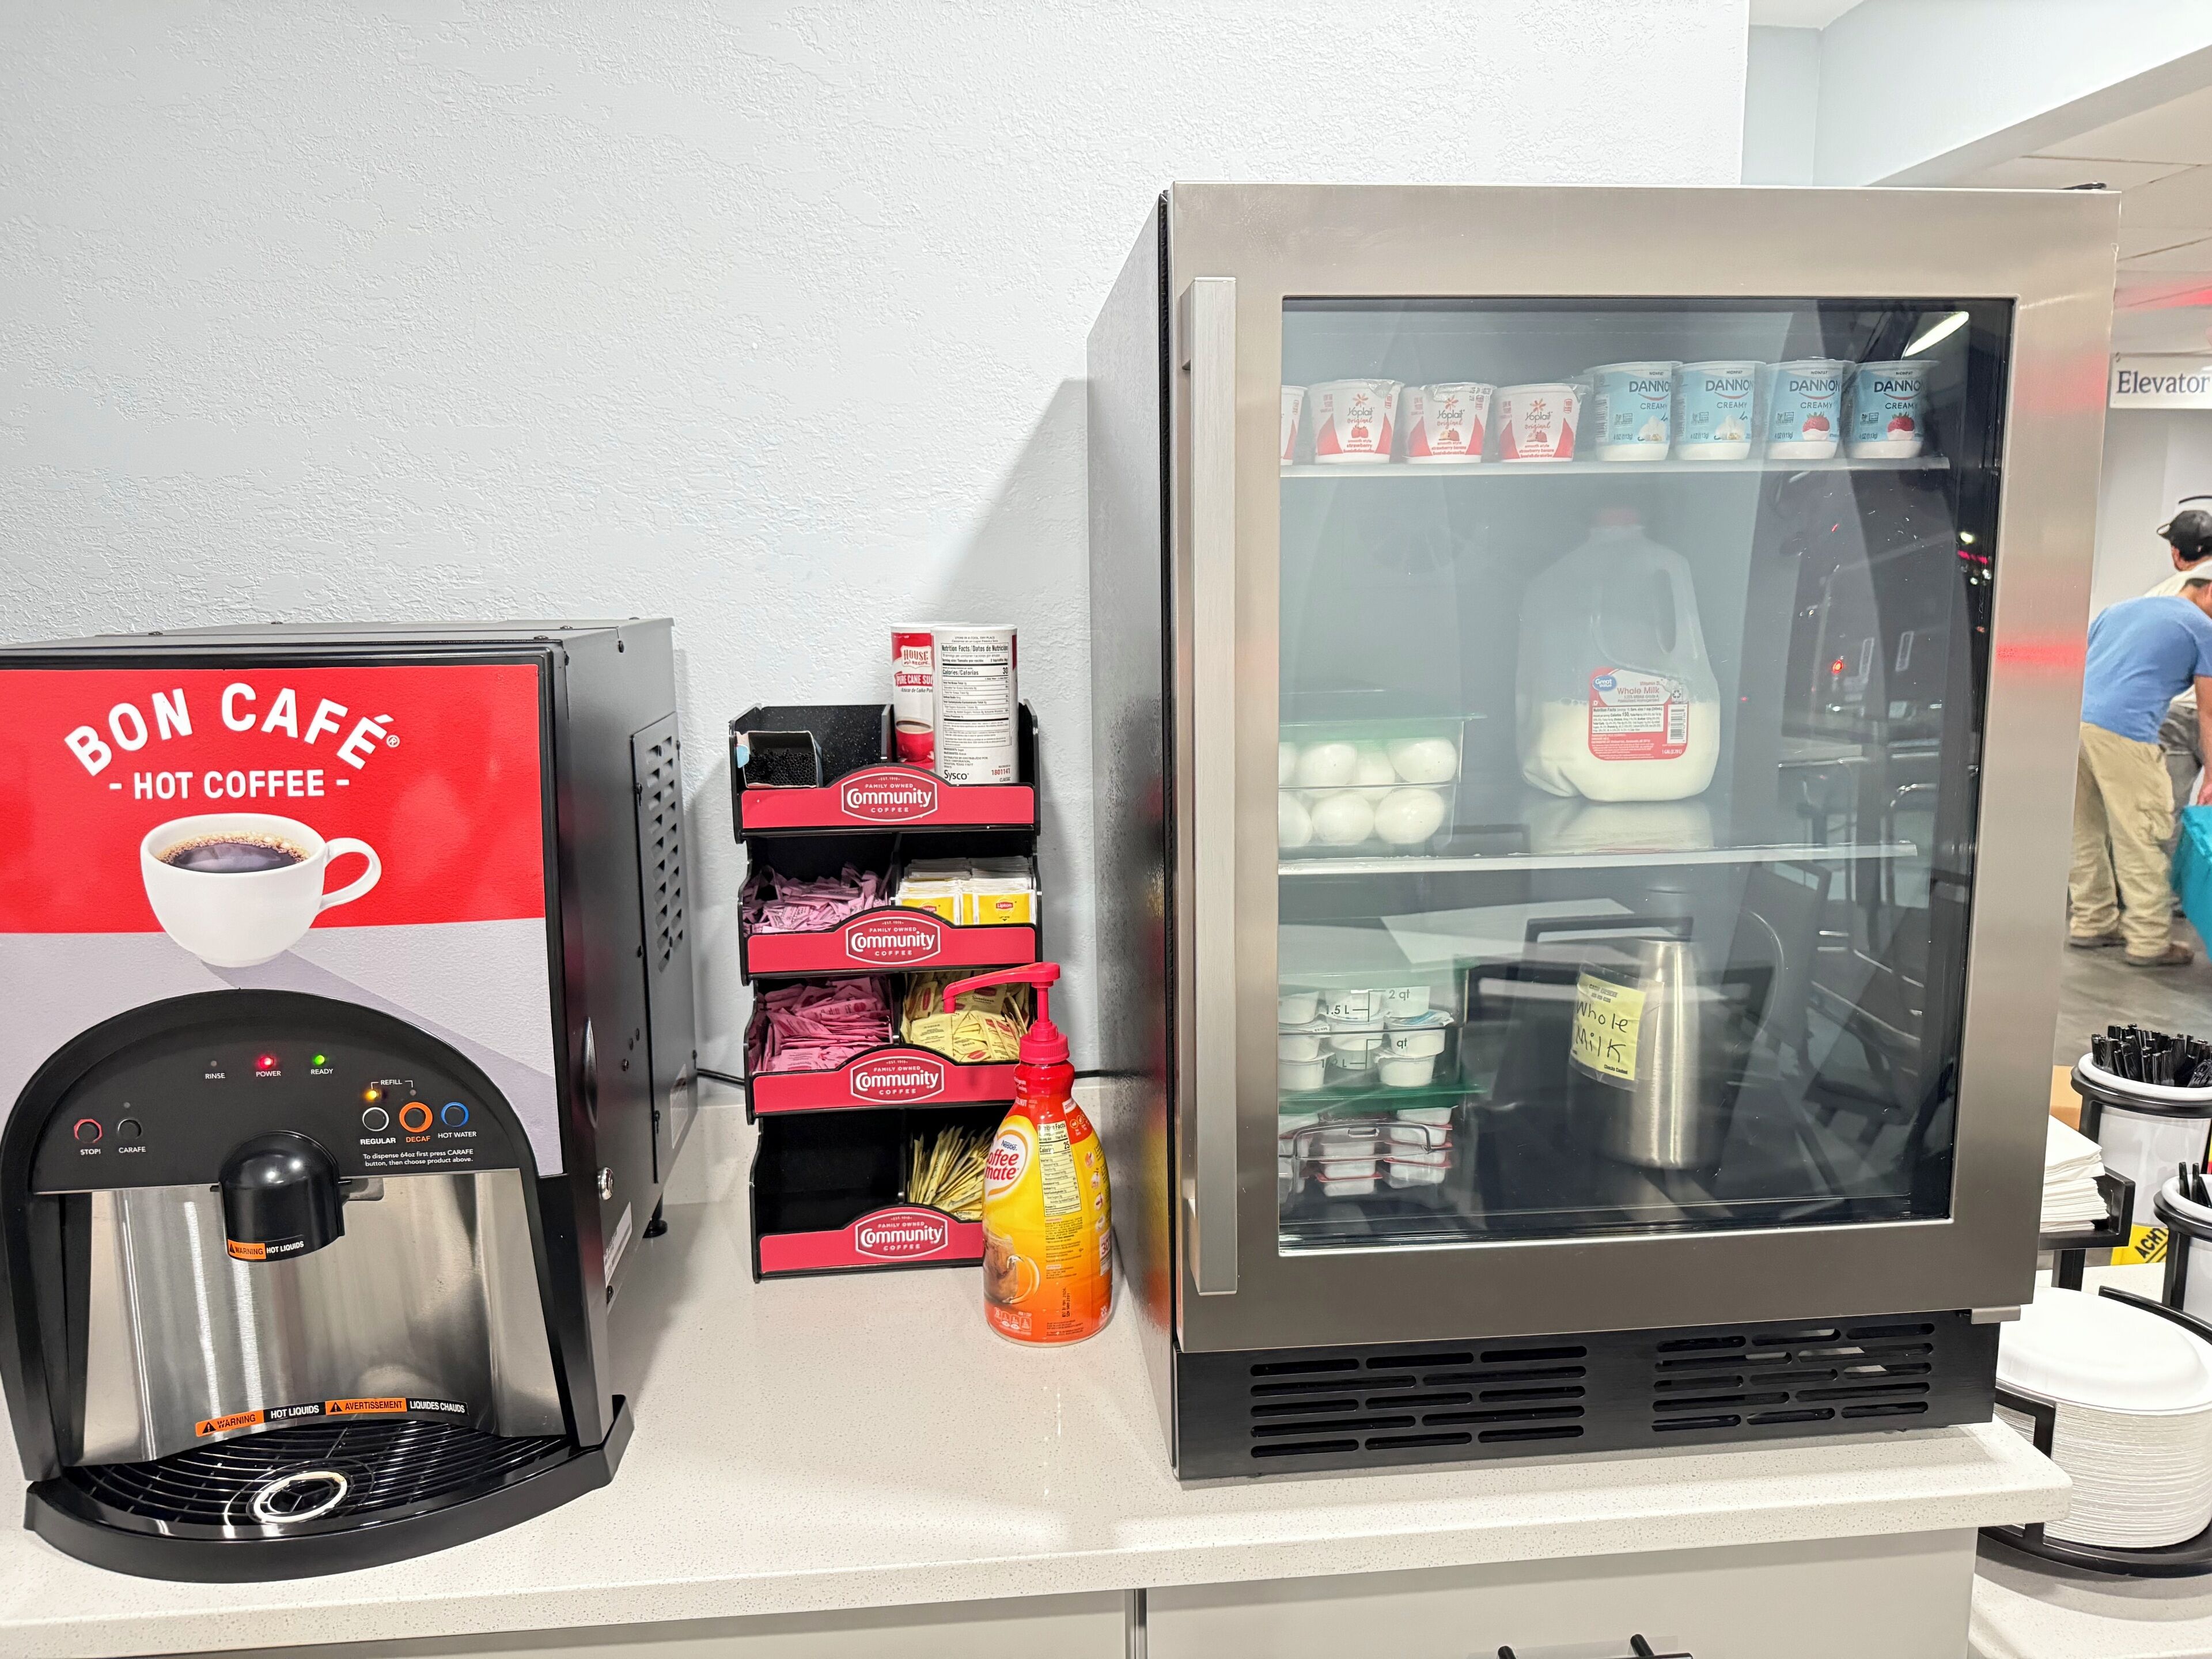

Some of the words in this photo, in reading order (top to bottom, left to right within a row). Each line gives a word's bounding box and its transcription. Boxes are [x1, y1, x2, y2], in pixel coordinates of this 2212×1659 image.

[1629, 380, 1671, 392] DANNO
[1706, 379, 1753, 392] DANNON
[1789, 380, 1840, 392] DANNON
[1874, 380, 1923, 392] DANNO
[2116, 370, 2210, 393] Elevator
[1347, 407, 1373, 418] Yoplait
[1437, 409, 1463, 422] Yoplait
[1525, 411, 1551, 423] Yoplait
[904, 649, 929, 661] HOUSE
[897, 675, 907, 685] PURE
[907, 675, 922, 684] CANE
[65, 688, 193, 777] BON
[221, 682, 394, 770] CAFÉ
[944, 770, 968, 781] Sysco
[133, 771, 193, 800] HOT
[203, 769, 324, 798] COFFEE
[846, 787, 932, 808] Community
[851, 930, 935, 952] Community
[1388, 989, 1395, 999] 2
[1399, 988, 1410, 1001] qt
[1326, 1005, 1340, 1014] 1.5
[1344, 1005, 1350, 1014] L
[1577, 1001, 1628, 1033] Whole
[1396, 1037, 1408, 1049] qt
[1575, 1025, 1626, 1063] Milk
[1343, 1059, 1347, 1068] L
[855, 1070, 939, 1092] Community
[360, 1137, 396, 1145] REGULAR
[1001, 1139, 1017, 1151] Nestlé
[1063, 1141, 1070, 1149] 25
[427, 1157, 451, 1165] product
[987, 1149, 1020, 1166] offee
[985, 1166, 1017, 1180] mate
[861, 1225, 943, 1248] Community
[235, 1246, 263, 1255] WARNING
[266, 1246, 279, 1254] HOT
[280, 1240, 304, 1252] LIQUIDS
[883, 1243, 921, 1251] COFFEE
[217, 1414, 256, 1430] WARNING
[270, 1407, 288, 1419] HOT
[289, 1404, 319, 1418] LIQUIDS
[344, 1400, 403, 1411] AVERTISSEMENT
[409, 1399, 440, 1411] LIQUIDES
[440, 1402, 465, 1414] CHAUDS
